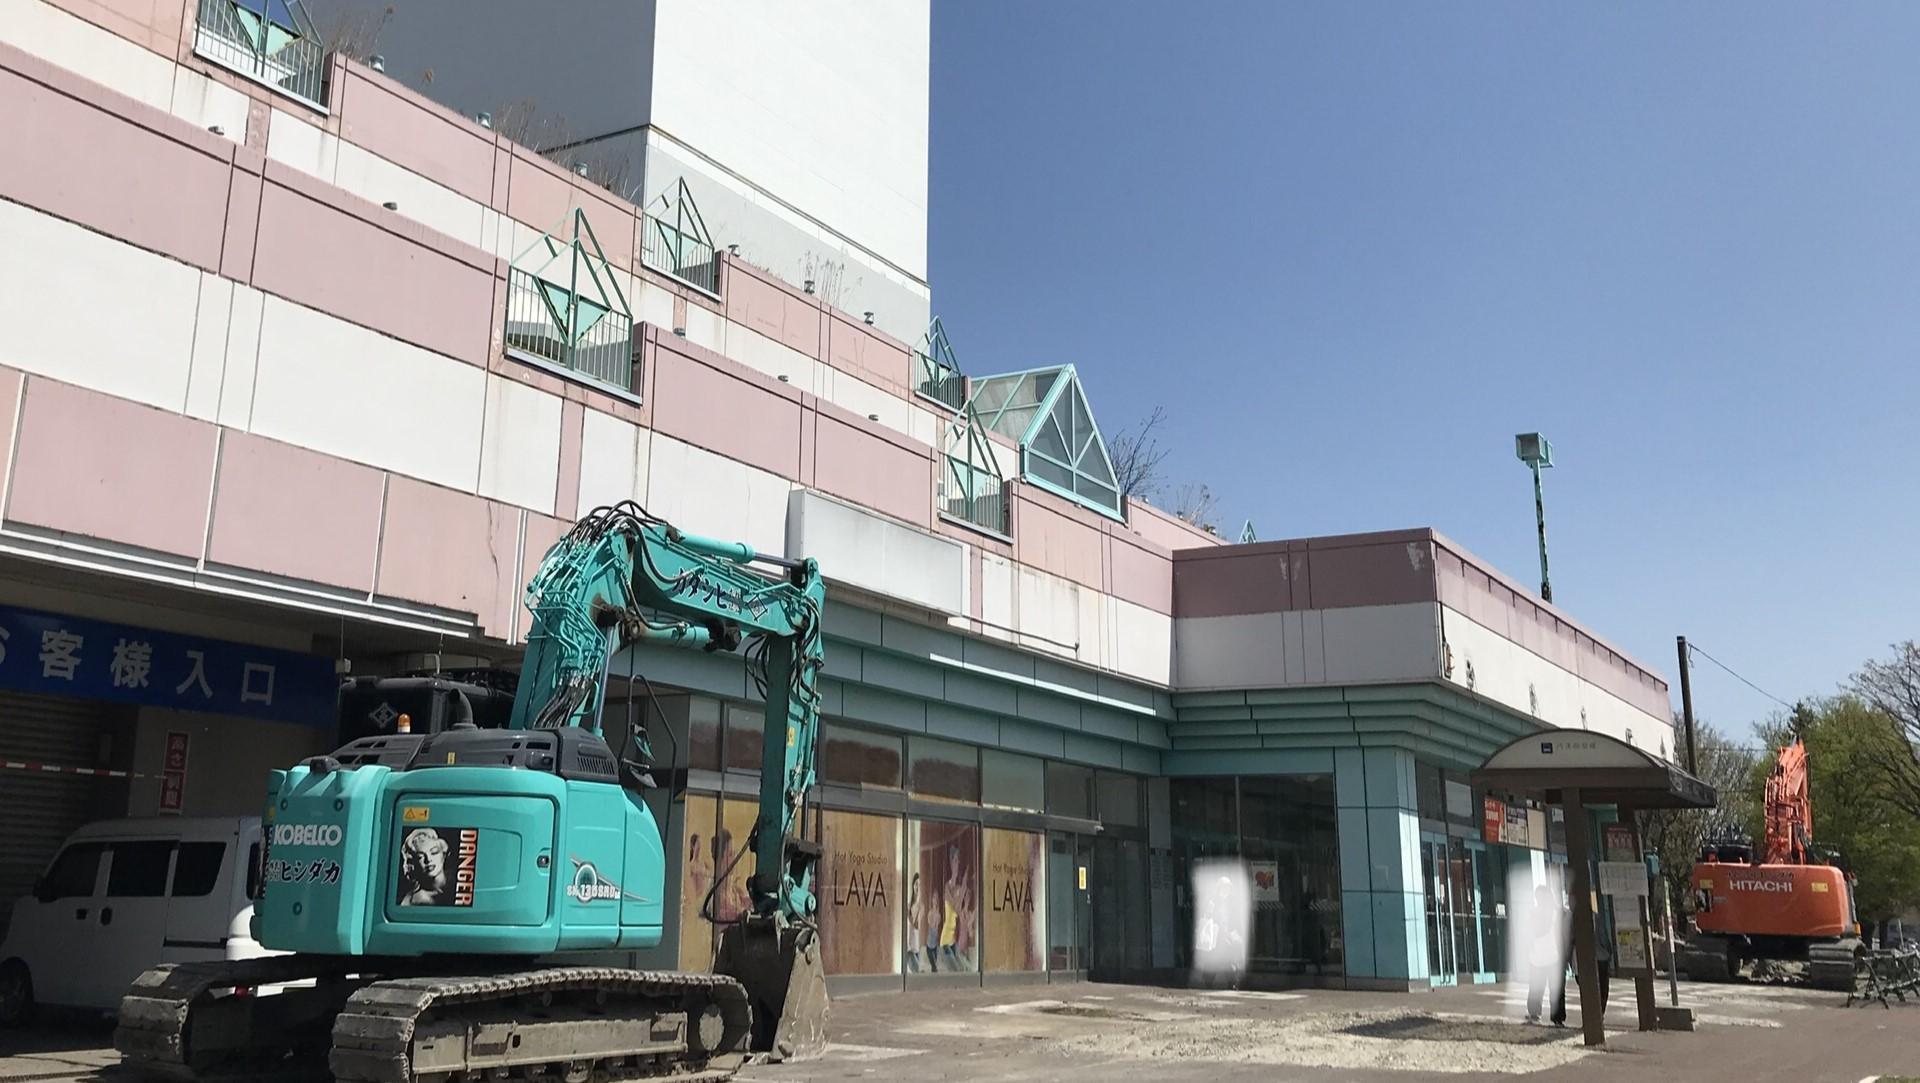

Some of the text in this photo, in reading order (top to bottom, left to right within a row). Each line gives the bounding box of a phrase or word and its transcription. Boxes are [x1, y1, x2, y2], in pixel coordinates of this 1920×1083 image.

[0, 626, 276, 706] 客様入口
[273, 823, 343, 847] KOBELCO
[454, 829, 477, 906] DANGER
[834, 870, 887, 907] LAVA
[992, 879, 1034, 912] LAVA
[1729, 880, 1792, 893] HITACHI
